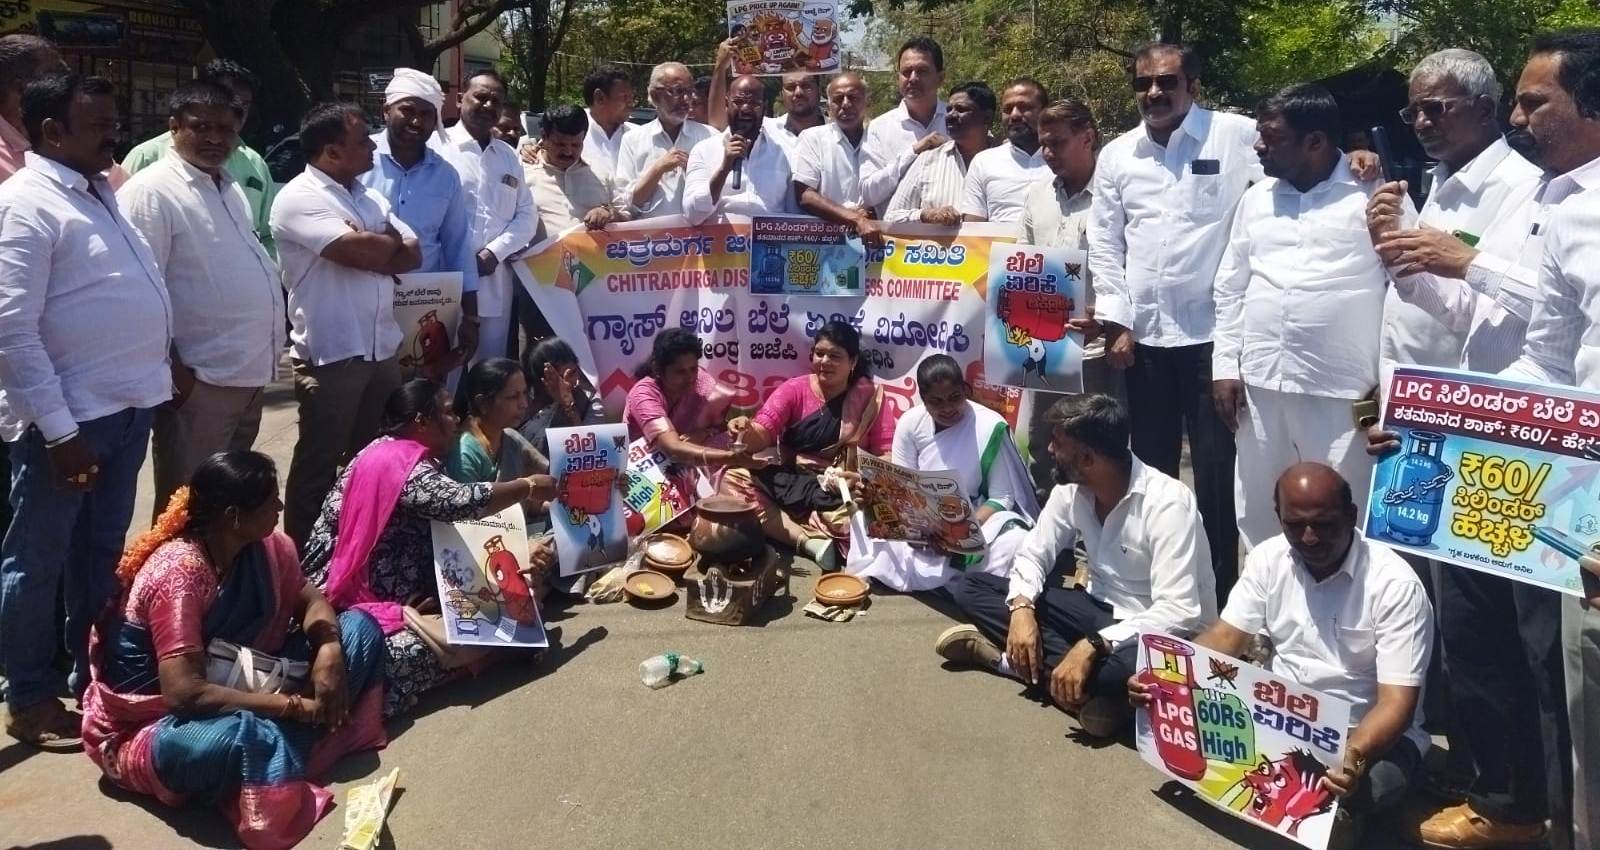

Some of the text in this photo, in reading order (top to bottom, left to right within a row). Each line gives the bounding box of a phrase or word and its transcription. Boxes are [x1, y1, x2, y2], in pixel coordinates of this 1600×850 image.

[749, 3, 768, 11] PRICE
[756, 223, 773, 231] LPG
[606, 234, 751, 266] ಚಿತ್ರದುರ್ಗ ಜಿ
[904, 244, 965, 265] ಸಮಿತಿ
[1006, 251, 1044, 274] ಬೆಲೆ
[607, 268, 748, 293] CHITRADURGA DIS
[865, 278, 961, 301] ESS COMMITTEE
[1005, 274, 1057, 295] ಏರಿಕೆ
[587, 304, 666, 355] ಗ್ಯಾಸ್
[679, 306, 736, 333] ಅನಿಲ
[748, 300, 790, 334] ಬೆಲೆ
[750, 338, 798, 360] ಬಿಜೆಪಿ
[1395, 380, 1600, 428] LPG ಸಿಲಿಂಡರ್ ಬೆಲೆ ಏ
[1393, 407, 1460, 429] ಶತಮಾನದ
[1463, 418, 1506, 437] ಶಾಕ್:
[1510, 424, 1558, 446] ₹60/-
[565, 432, 597, 454] ಬೆಲೆ
[566, 450, 608, 472] ಏರಿಕೆ
[1459, 451, 1551, 502] ₹60/
[628, 486, 654, 509] High
[1452, 485, 1545, 521] ಸಿಲಿಂಡರ್
[1397, 506, 1429, 524] 14.2 kg
[1451, 511, 1536, 557] ಹೆಚ್ಚಳ
[1156, 697, 1194, 725] LPG
[1198, 701, 1246, 730] 60Rs
[1253, 680, 1319, 723] ಬೆಲೆ
[1159, 723, 1198, 751] GAS
[1253, 704, 1340, 755] ಏರಿಕೆ
[1203, 731, 1246, 763] High
